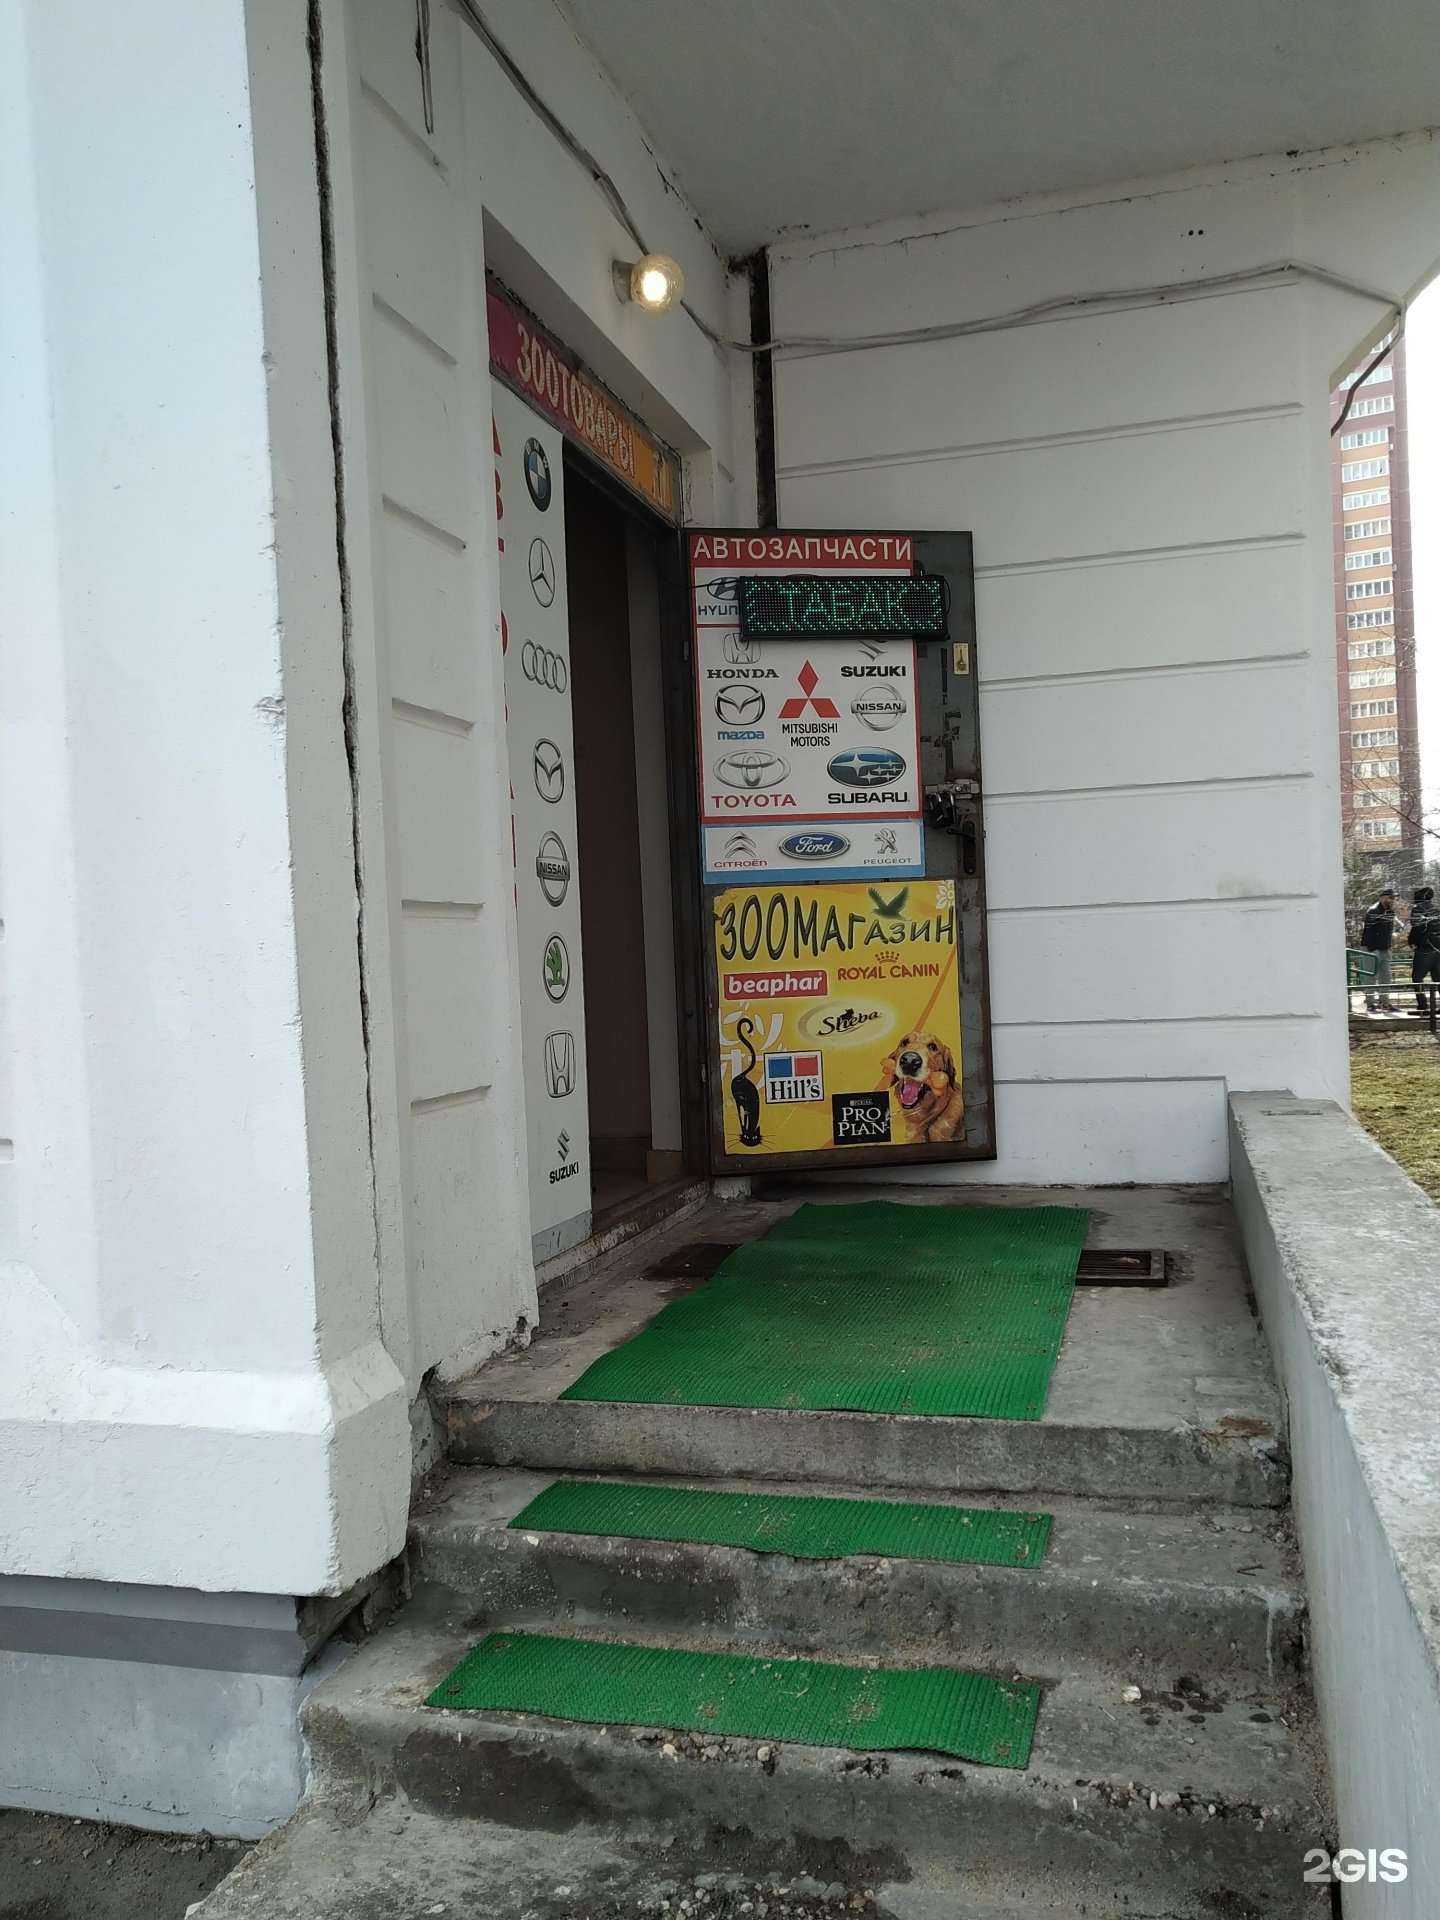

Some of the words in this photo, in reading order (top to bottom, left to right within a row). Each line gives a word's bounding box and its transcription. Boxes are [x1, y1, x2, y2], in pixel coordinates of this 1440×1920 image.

[517, 323, 635, 478] ЗООТОВАРЫ
[694, 537, 912, 561] АВТОЗАПЧАСТИ
[698, 605, 738, 615] HYUN
[779, 585, 909, 624] ТАБАК
[707, 668, 780, 679] HONDA
[841, 665, 907, 678] SUZUKI
[856, 703, 902, 712] NISSAN
[782, 723, 838, 734] MITSUBISHI
[790, 736, 830, 747] MOTORS
[711, 794, 797, 808] TOYOTA
[828, 791, 907, 804] SUBARU
[795, 836, 833, 853] Ford
[539, 861, 568, 876] NISSAN
[863, 857, 912, 865] PEUGEOT
[837, 965, 887, 980] ROYAL
[890, 963, 940, 977] CANIN
[728, 972, 823, 997] beaphar
[818, 1009, 880, 1037] Sheba
[770, 1078, 821, 1101] Hill's
[842, 1107, 881, 1122] PRO
[838, 1121, 885, 1137] PLAN
[548, 1162, 580, 1185] SUZUKI
